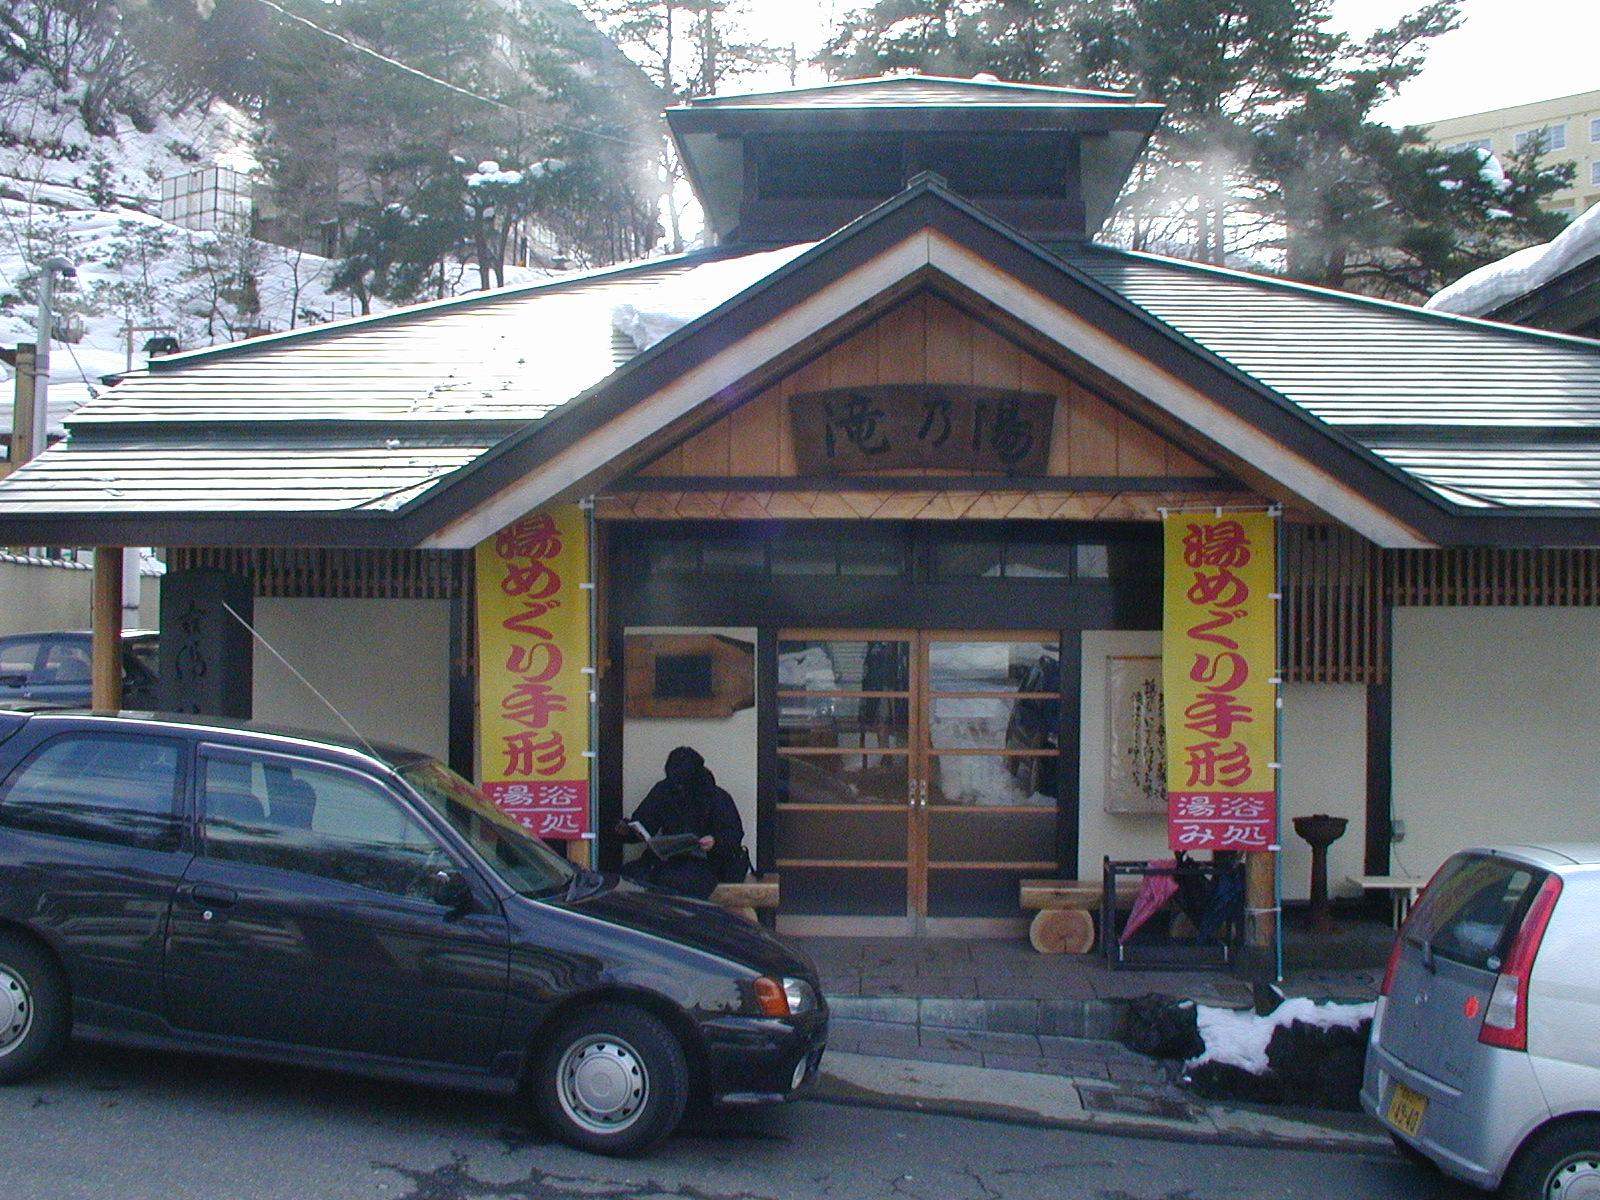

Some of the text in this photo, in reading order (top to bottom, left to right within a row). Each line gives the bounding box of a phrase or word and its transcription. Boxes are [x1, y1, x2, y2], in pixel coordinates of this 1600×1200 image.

[495, 512, 568, 777] 湯めぐり手形
[1182, 520, 1254, 788] 湯めぐり手形
[1179, 825, 1267, 846] み処
